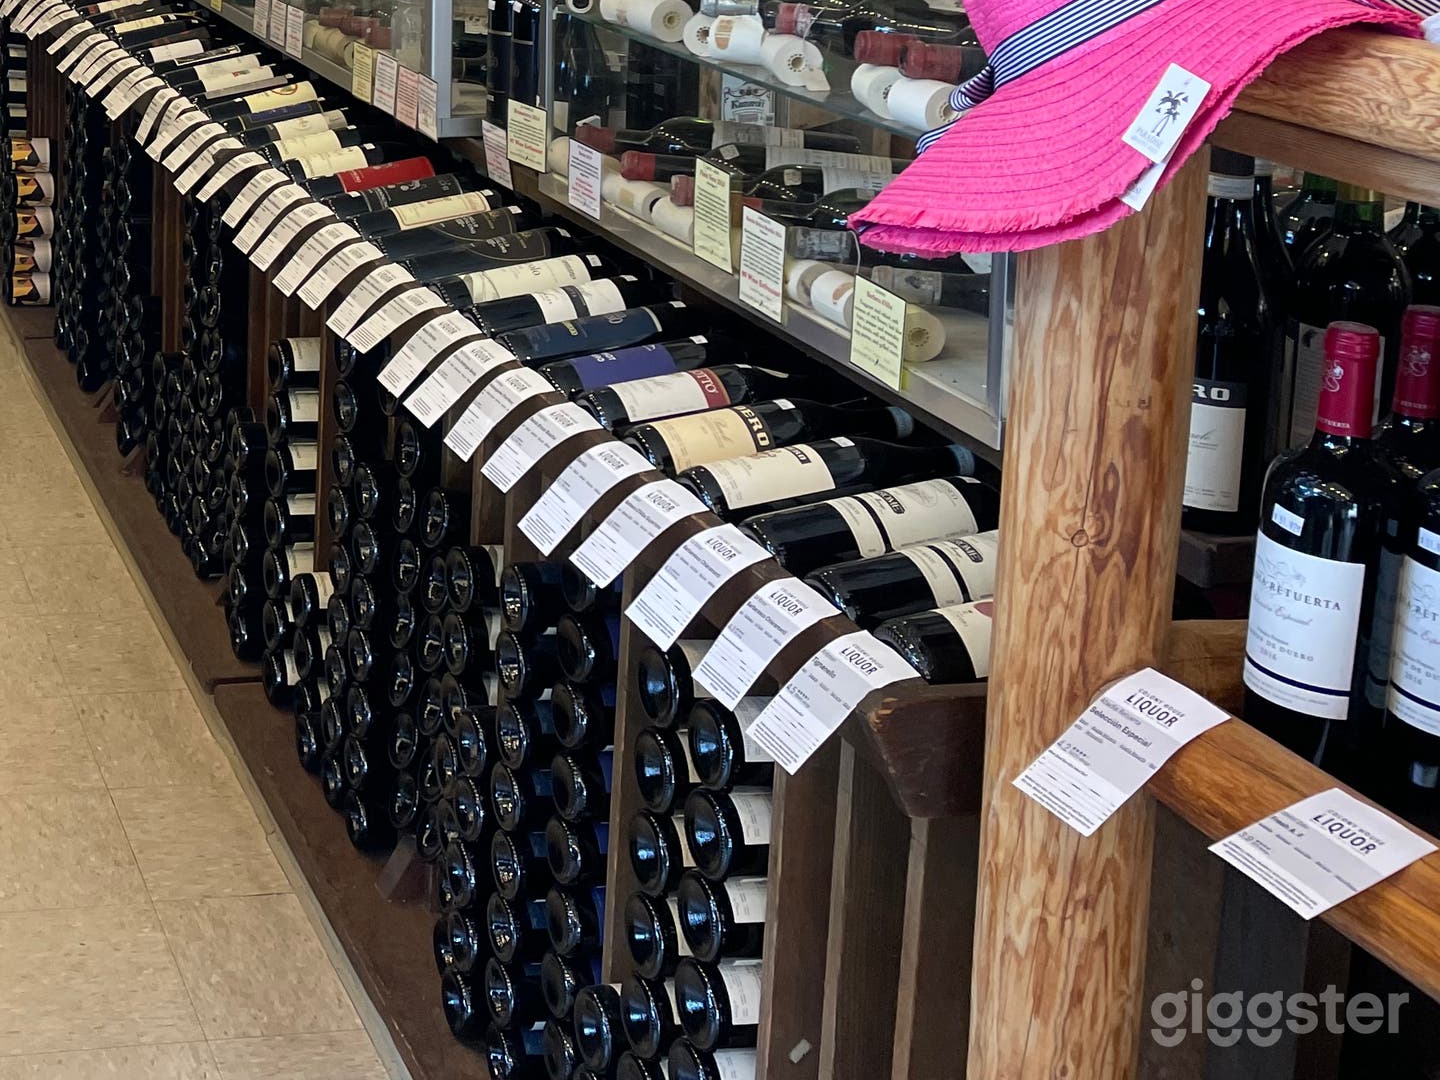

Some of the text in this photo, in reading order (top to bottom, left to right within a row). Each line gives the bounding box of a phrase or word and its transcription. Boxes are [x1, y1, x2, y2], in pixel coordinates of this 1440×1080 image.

[597, 450, 625, 472] LIQUOR
[646, 490, 675, 513] LIQUOR
[705, 536, 737, 562] LIQUOR
[769, 590, 803, 617] LIQUOR
[840, 647, 878, 677] LIQUOR
[1126, 692, 1179, 728] LIQUOR
[1138, 688, 1185, 718] COLONY HOUSE
[1089, 705, 1122, 729] Selección
[1121, 726, 1153, 748] Especial
[1312, 814, 1377, 855] LIQUOR
